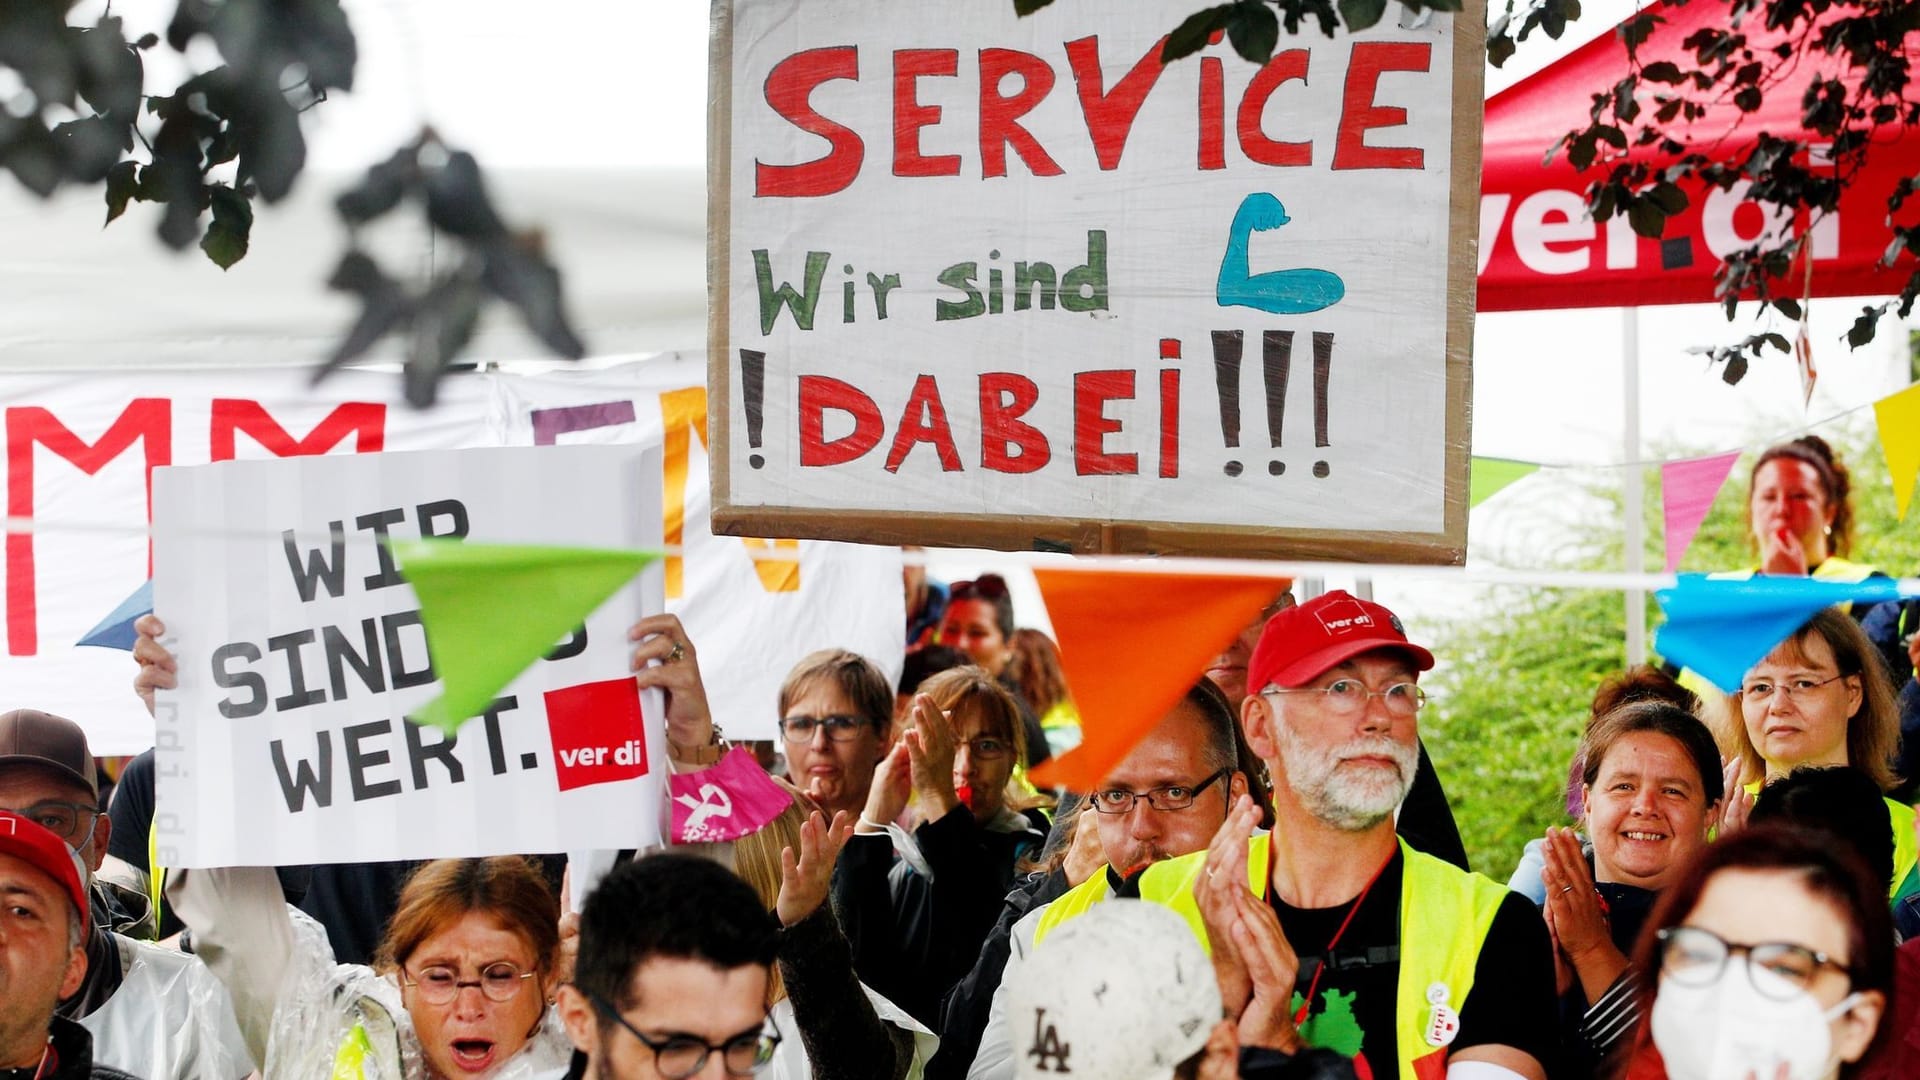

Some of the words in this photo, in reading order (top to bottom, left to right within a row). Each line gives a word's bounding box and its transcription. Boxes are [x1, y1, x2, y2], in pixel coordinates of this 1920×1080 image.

[752, 248, 902, 337] Wir
[936, 229, 1109, 322] sind
[1326, 615, 1370, 630] verdi
[155, 636, 190, 867] rdi.de
[269, 695, 539, 814] WERT.
[559, 740, 641, 768] ver.di
[1028, 1007, 1072, 1073] LA
